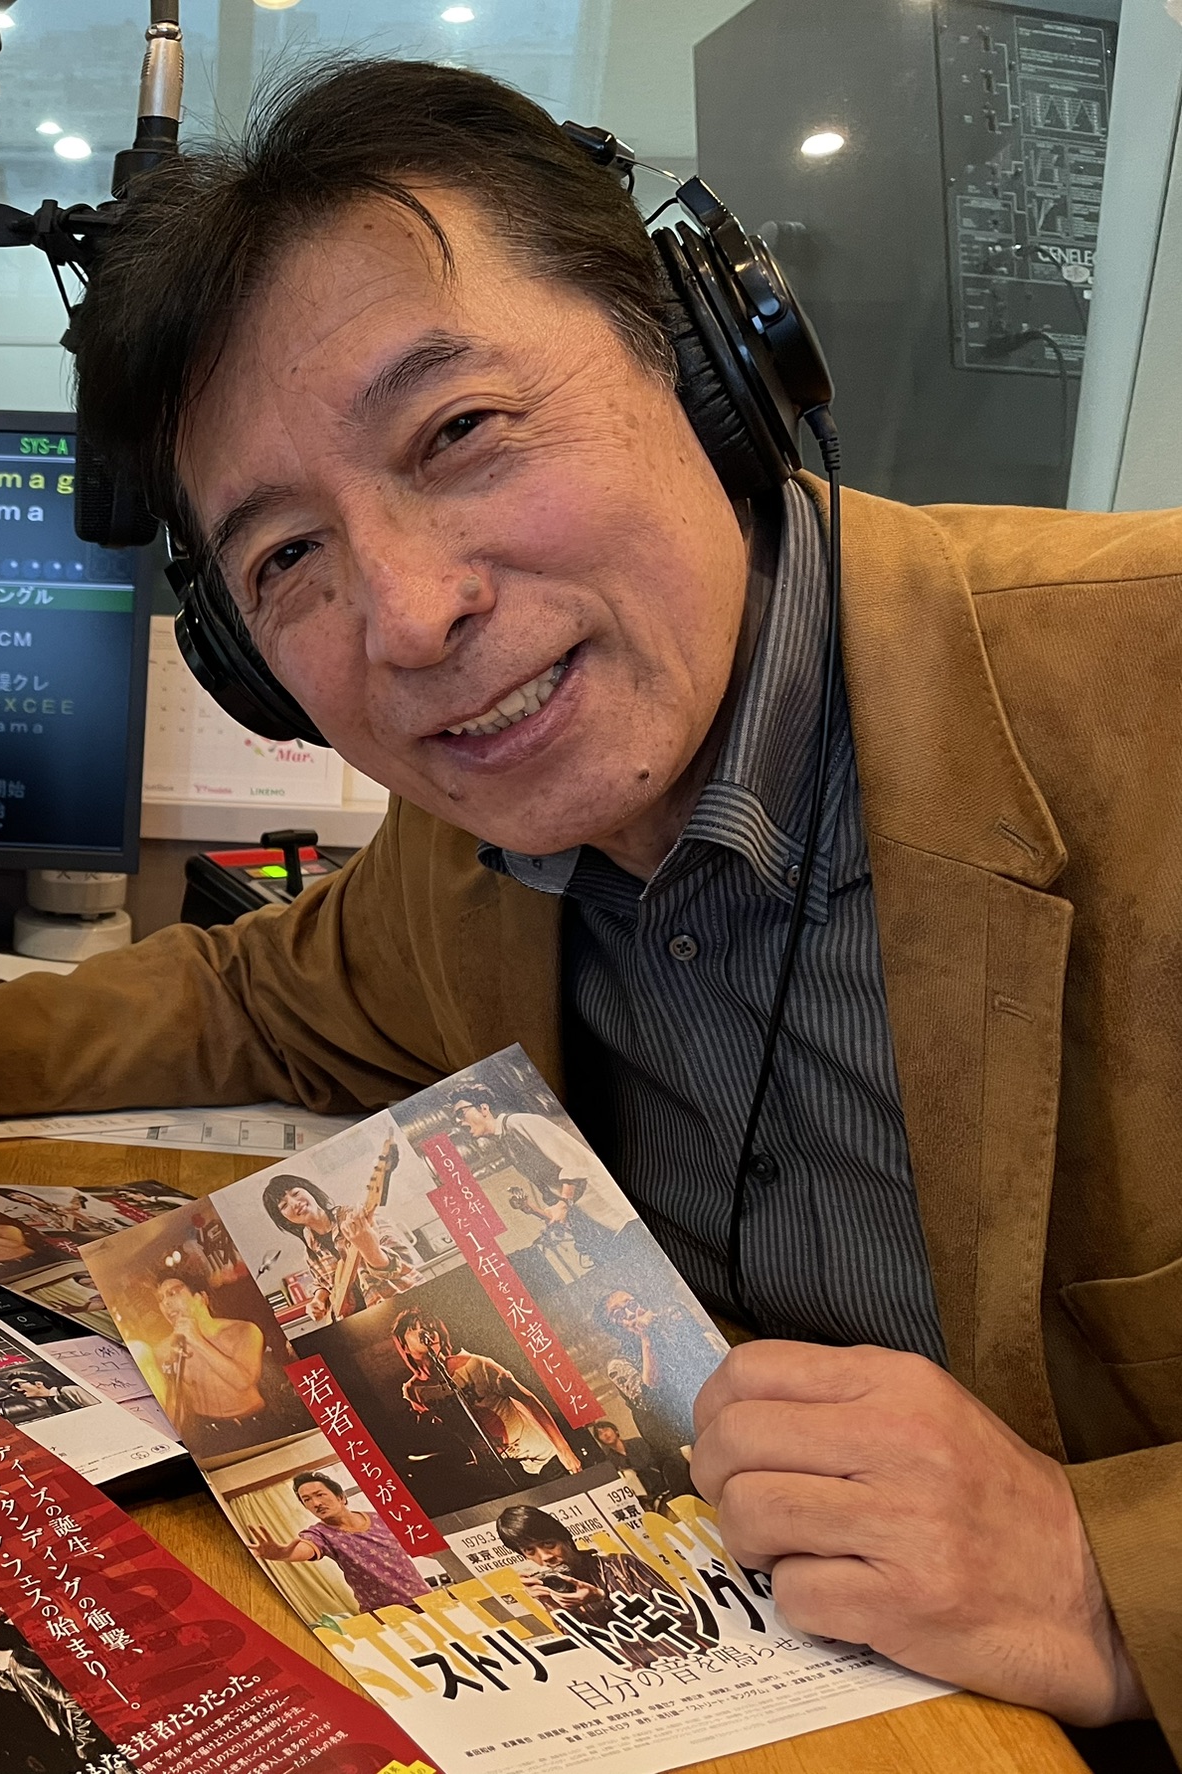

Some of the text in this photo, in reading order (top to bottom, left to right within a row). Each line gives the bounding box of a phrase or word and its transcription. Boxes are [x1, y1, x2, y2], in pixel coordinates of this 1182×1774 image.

[20, 436, 68, 455] SYS-A
[297, 1366, 430, 1545] 若者たちがいた
[607, 1486, 635, 1504] 1979
[566, 1636, 814, 1712] 自分の音を鳴らせ。
[74, 1673, 262, 1774] もなき若者たちだった。
